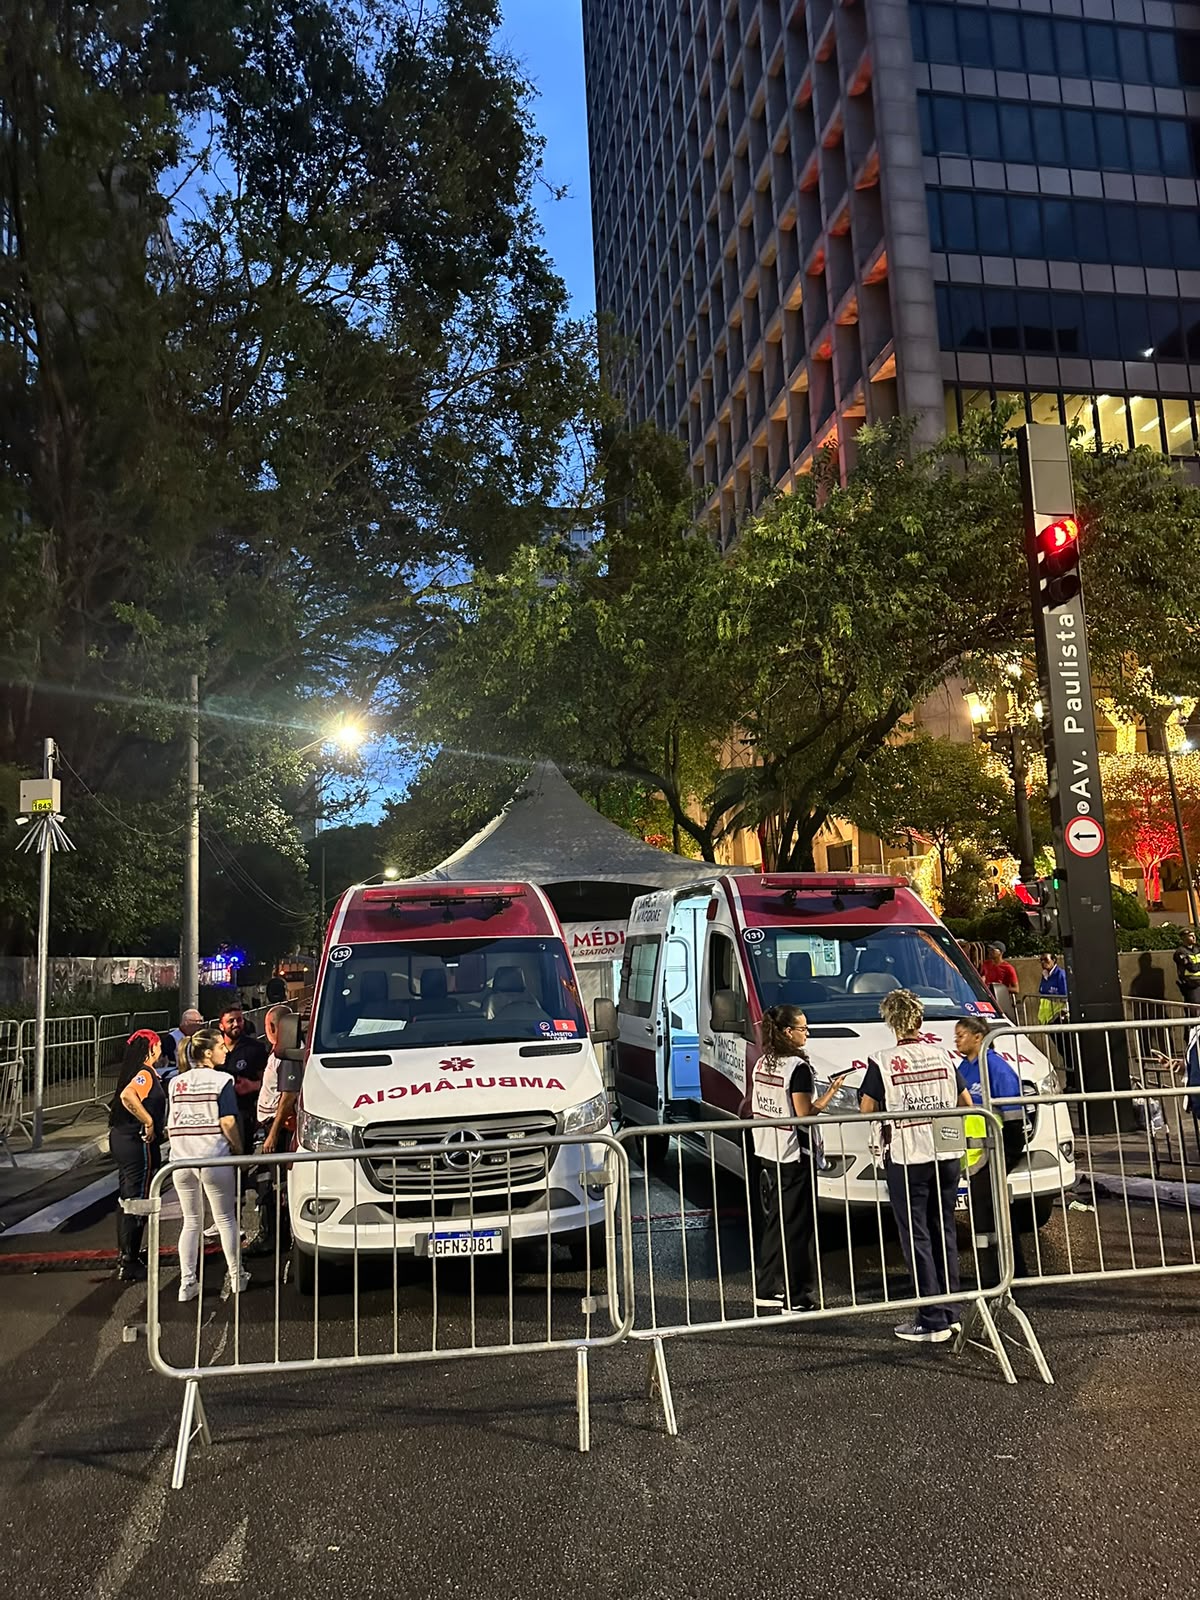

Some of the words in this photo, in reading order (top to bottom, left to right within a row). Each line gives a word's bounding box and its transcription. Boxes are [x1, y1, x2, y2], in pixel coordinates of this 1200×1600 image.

[1056, 613, 1085, 733] Paulista
[1070, 750, 1092, 799] Av.
[573, 926, 625, 947] MÉDI
[747, 932, 761, 940] 131
[334, 950, 349, 959] 133
[579, 947, 616, 957] STATION
[435, 1237, 494, 1255] GFN3J81
